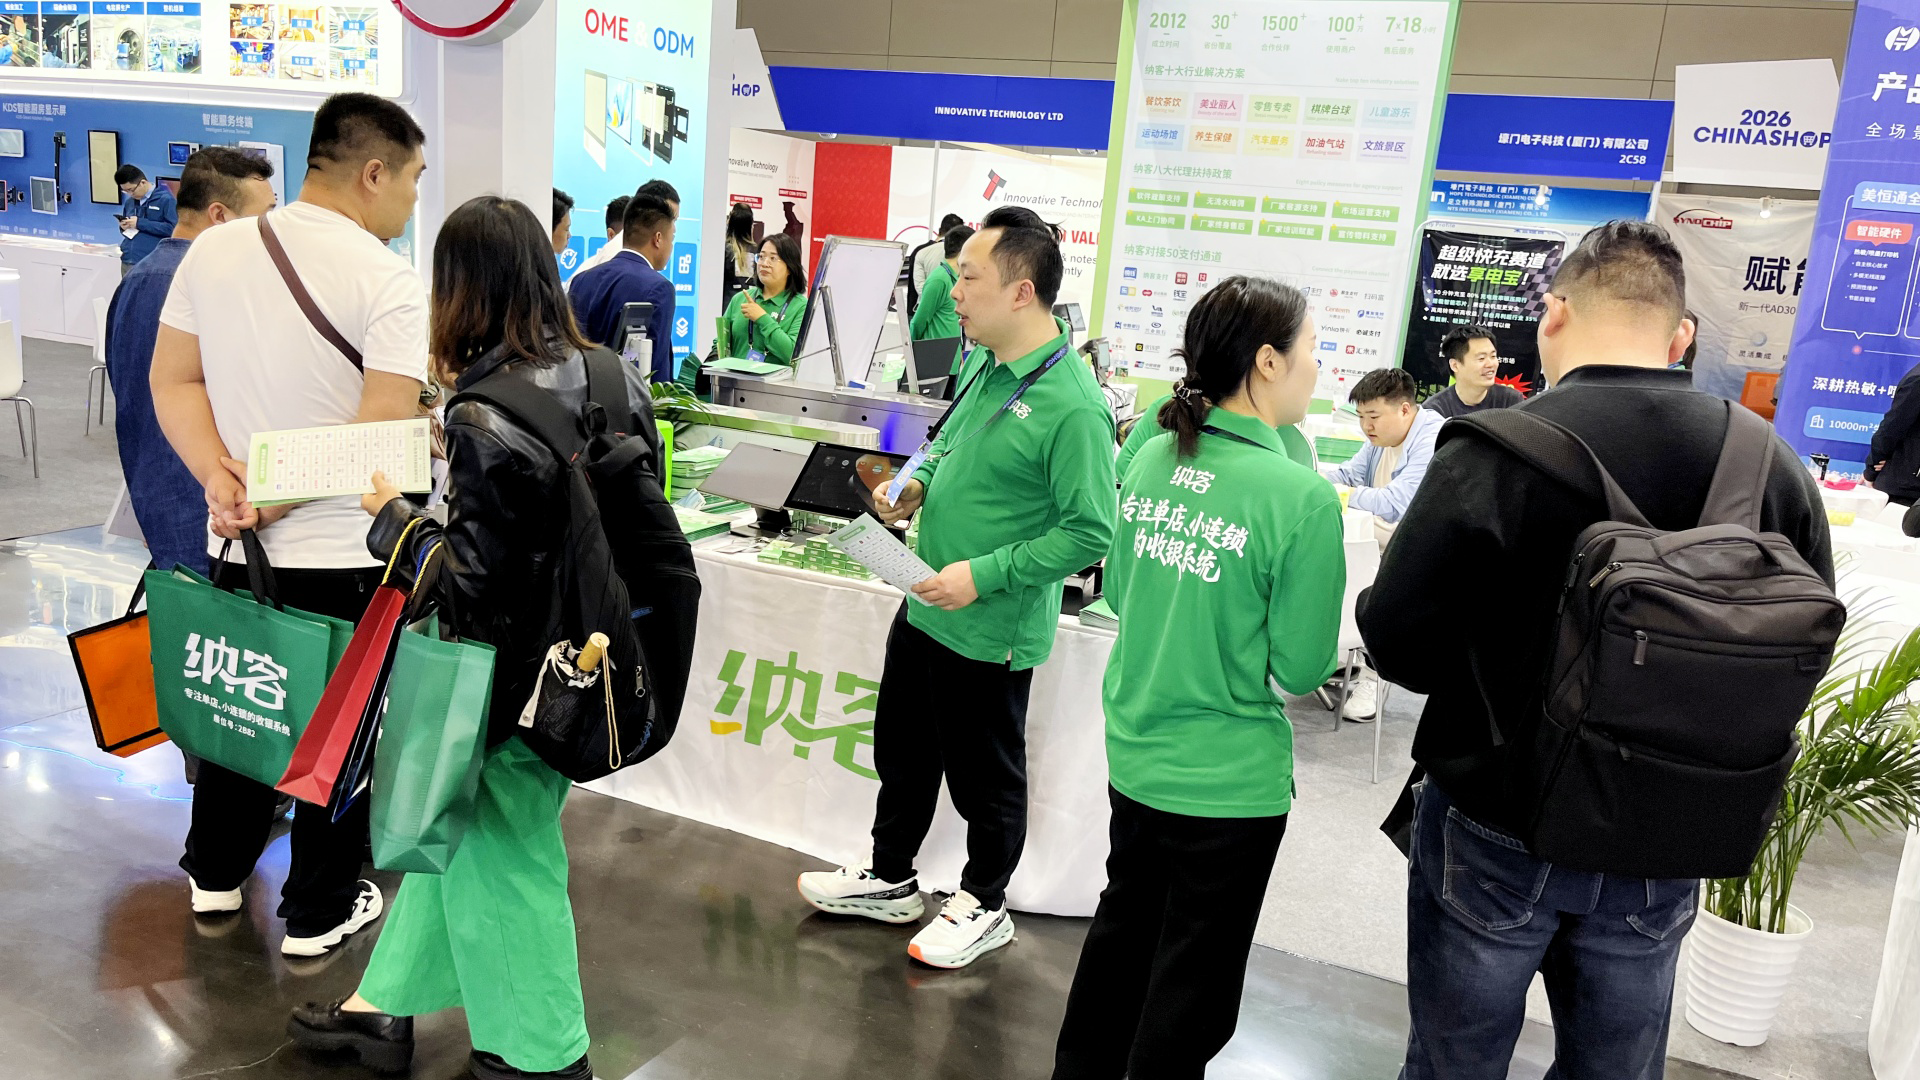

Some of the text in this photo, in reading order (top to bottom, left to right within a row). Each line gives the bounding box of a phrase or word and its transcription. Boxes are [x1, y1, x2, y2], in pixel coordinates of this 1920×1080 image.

[1150, 12, 1187, 30] 2012
[584, 8, 694, 58] OME & ODM
[1151, 40, 1180, 49] 成立时间
[1204, 42, 1233, 51] 省份覆盖
[1261, 44, 1291, 52] 合作伙伴
[1326, 45, 1356, 54] 使用商户
[1384, 46, 1415, 56] 售后服务
[1144, 65, 1246, 80] 纳客十大行业解决方案
[1146, 96, 1182, 107] 餐饮茶饮
[1200, 98, 1236, 110] 美业丽人
[1253, 101, 1292, 114] 零售专卖
[2, 102, 66, 116] KDS智能厨房显示屏
[934, 106, 1064, 121] INNOVATIVE TECHNOLOGY LTD
[1310, 104, 1352, 116] 棋牌台球
[1370, 106, 1410, 118] 儿童游乐
[202, 113, 253, 129] 智能服务终端
[1740, 109, 1792, 128] 2026
[1142, 128, 1178, 140] 运动场馆
[1194, 131, 1232, 142] 养生保健
[1250, 134, 1289, 146] 汽车服务
[1694, 126, 1832, 148] CHINASHOP
[1305, 137, 1346, 150] 加油气站
[1363, 140, 1406, 153] 文旅景区
[1618, 154, 1646, 164] 2C58
[750, 159, 778, 173] Technology
[1134, 163, 1232, 180] 纳客八大代理扶持政策
[1004, 193, 1056, 206] Innovative
[1861, 188, 1920, 207] 美恒通全
[1342, 207, 1390, 218] 市场运营支持
[1136, 215, 1176, 225] KA上门协同
[1200, 220, 1246, 230] 厂家终身售后
[1338, 230, 1387, 242] 宣传物料支持
[1856, 225, 1902, 240] 智能硬件
[1437, 244, 1548, 270] 超级快充赛道
[1738, 350, 1772, 360] 灵活集成
[1170, 466, 1216, 494] 纳客
[1122, 492, 1249, 558] 专注单店、小连锁
[1134, 528, 1221, 582] 的收银系统
[184, 632, 288, 710] 纳客
[184, 688, 290, 736] 专注单店、小连锁的收银系统
[864, 884, 910, 899] SKECHERS
